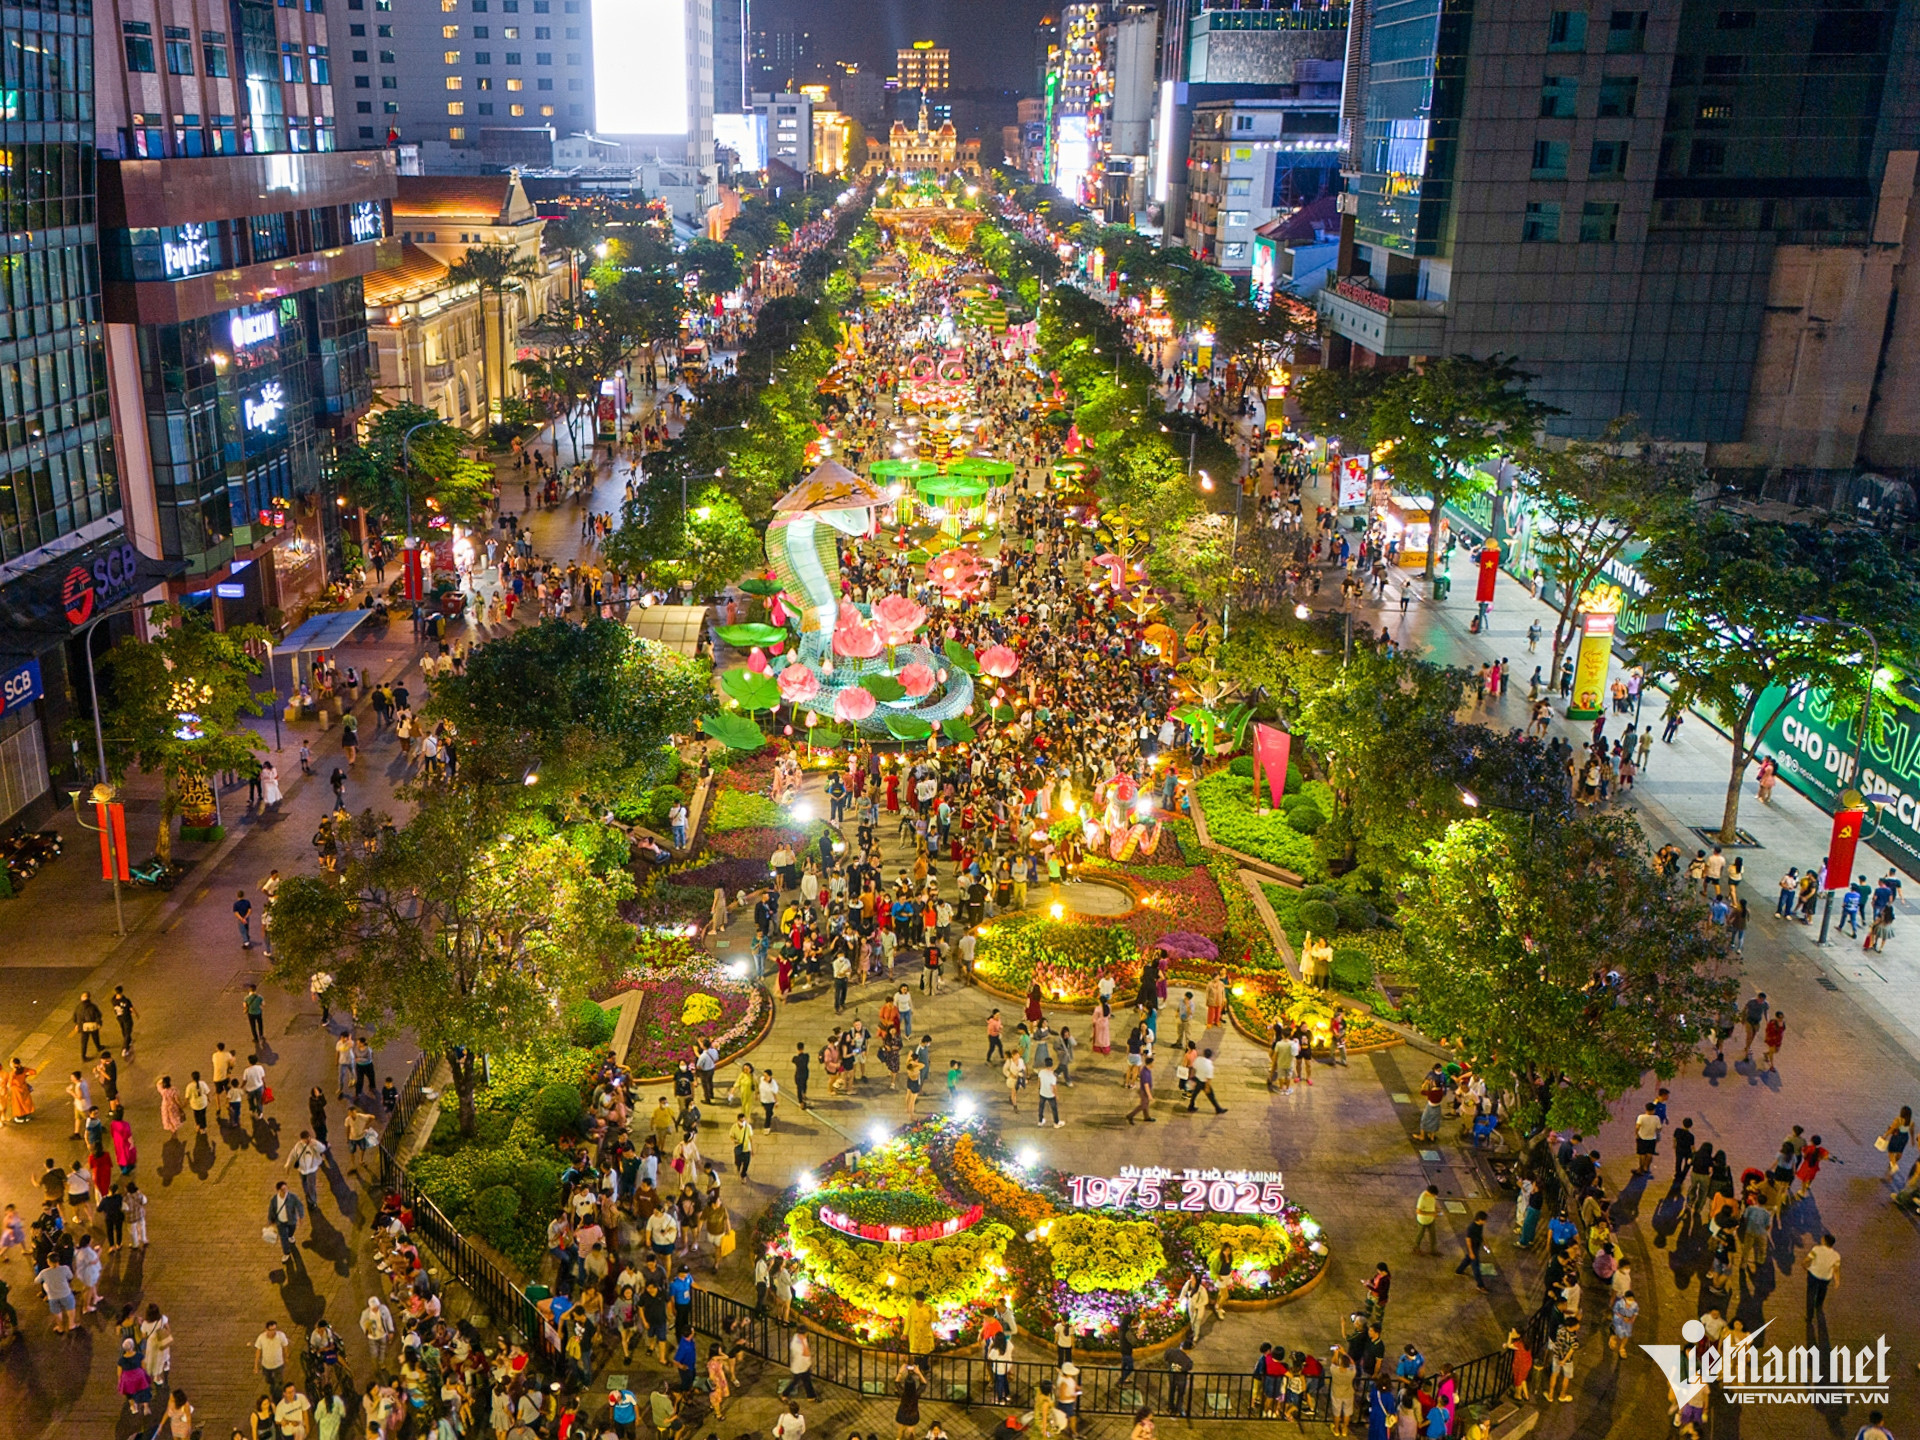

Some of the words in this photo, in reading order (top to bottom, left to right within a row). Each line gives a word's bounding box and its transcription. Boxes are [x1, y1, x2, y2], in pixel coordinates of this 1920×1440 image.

[94, 543, 136, 595] SCB
[4, 669, 32, 701] SCB
[1782, 715, 1823, 760] CHO
[181, 792, 213, 804] 2025
